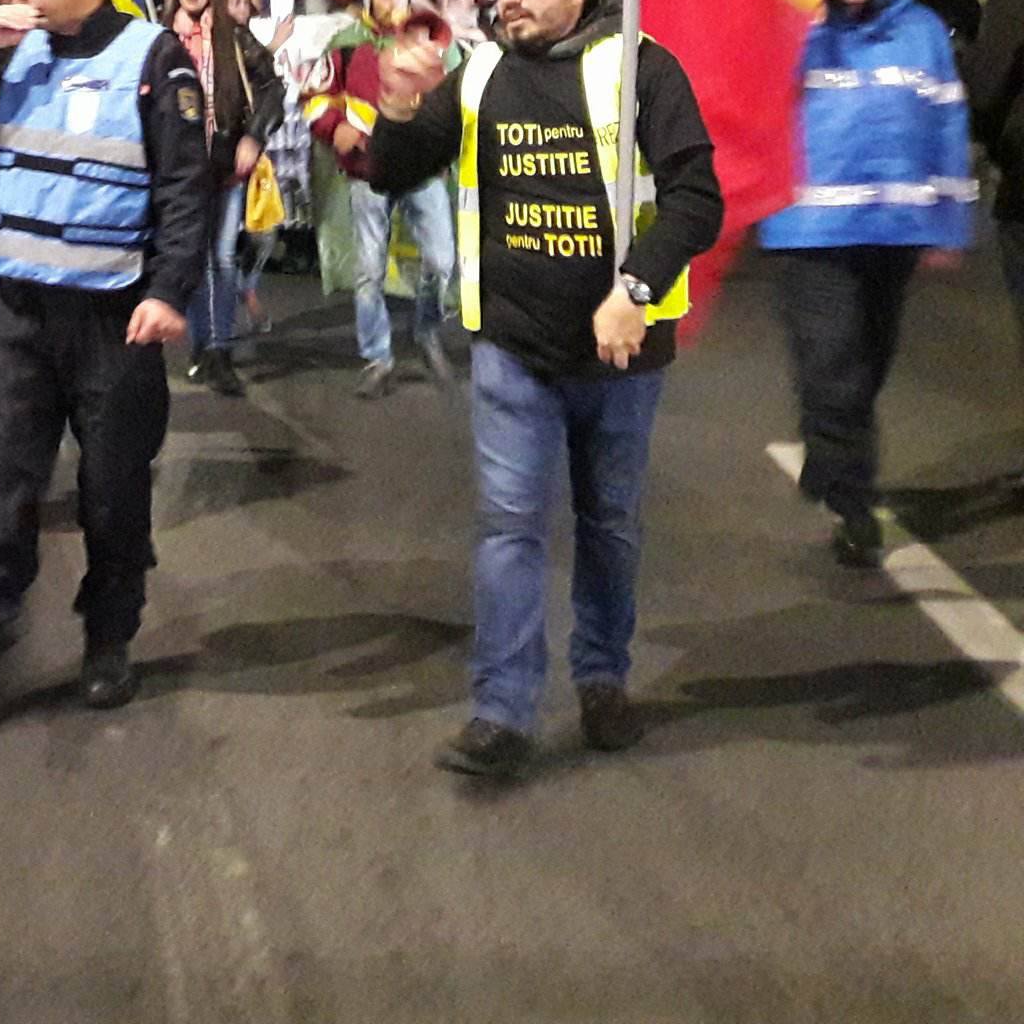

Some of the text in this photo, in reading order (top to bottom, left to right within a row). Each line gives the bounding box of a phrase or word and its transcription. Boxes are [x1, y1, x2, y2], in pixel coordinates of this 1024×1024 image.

[496, 123, 584, 146] TOTI pentru
[499, 151, 591, 176] JUSTITIE
[505, 201, 598, 229] JUSTITIE
[505, 232, 603, 257] pentru TOTI!
